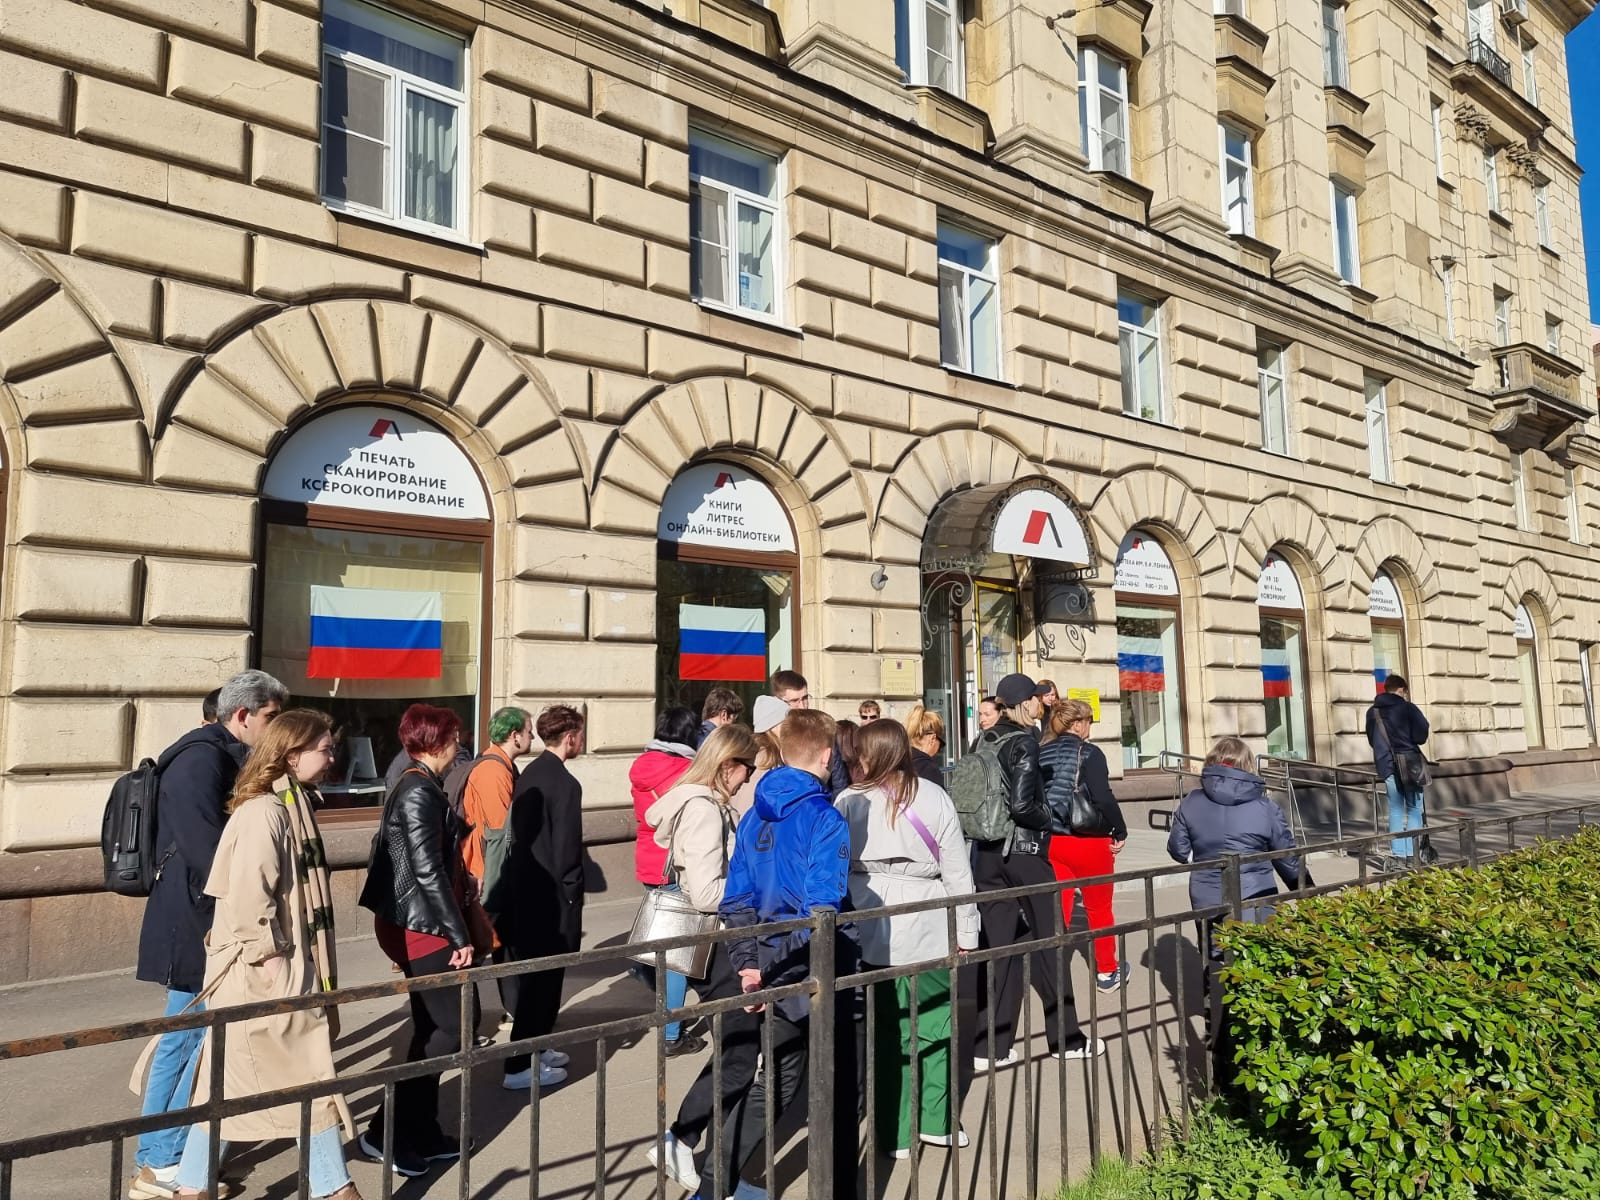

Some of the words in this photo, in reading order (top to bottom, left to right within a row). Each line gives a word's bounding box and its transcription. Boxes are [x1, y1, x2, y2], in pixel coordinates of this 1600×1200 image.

[359, 451, 416, 469] ПЕЧАТЬ
[323, 463, 447, 490] СКАНИРОВАНИЕ
[301, 477, 465, 508] КСЕРОКОПИРОВАНИЕ
[709, 499, 742, 512] КНИГИ
[706, 513, 745, 526] ЛИТРЕС
[666, 521, 781, 543] ОНЛАЙН-БИБЛИОТЕКИ
